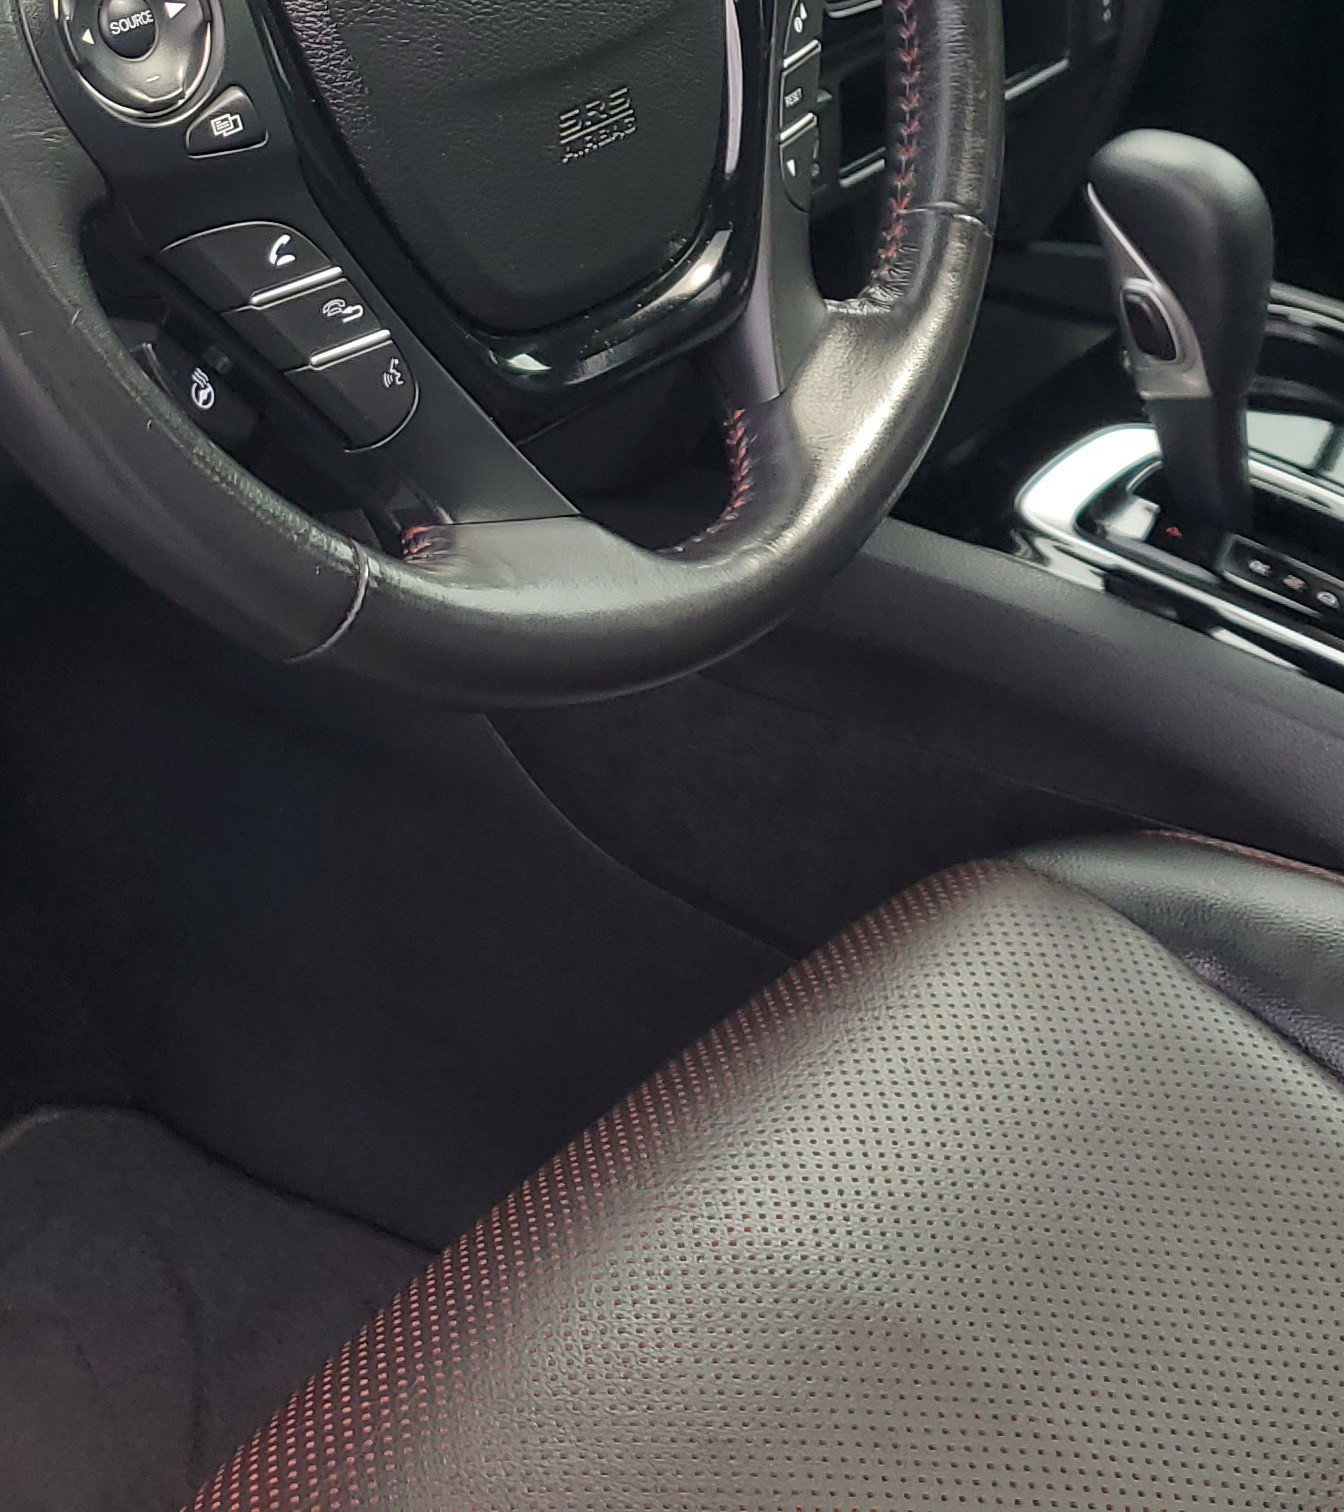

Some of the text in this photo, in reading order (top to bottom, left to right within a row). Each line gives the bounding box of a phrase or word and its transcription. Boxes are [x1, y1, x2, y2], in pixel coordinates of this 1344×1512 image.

[109, 9, 154, 36] SOURCE
[784, 88, 802, 108] RESET
[559, 87, 631, 137] SRS
